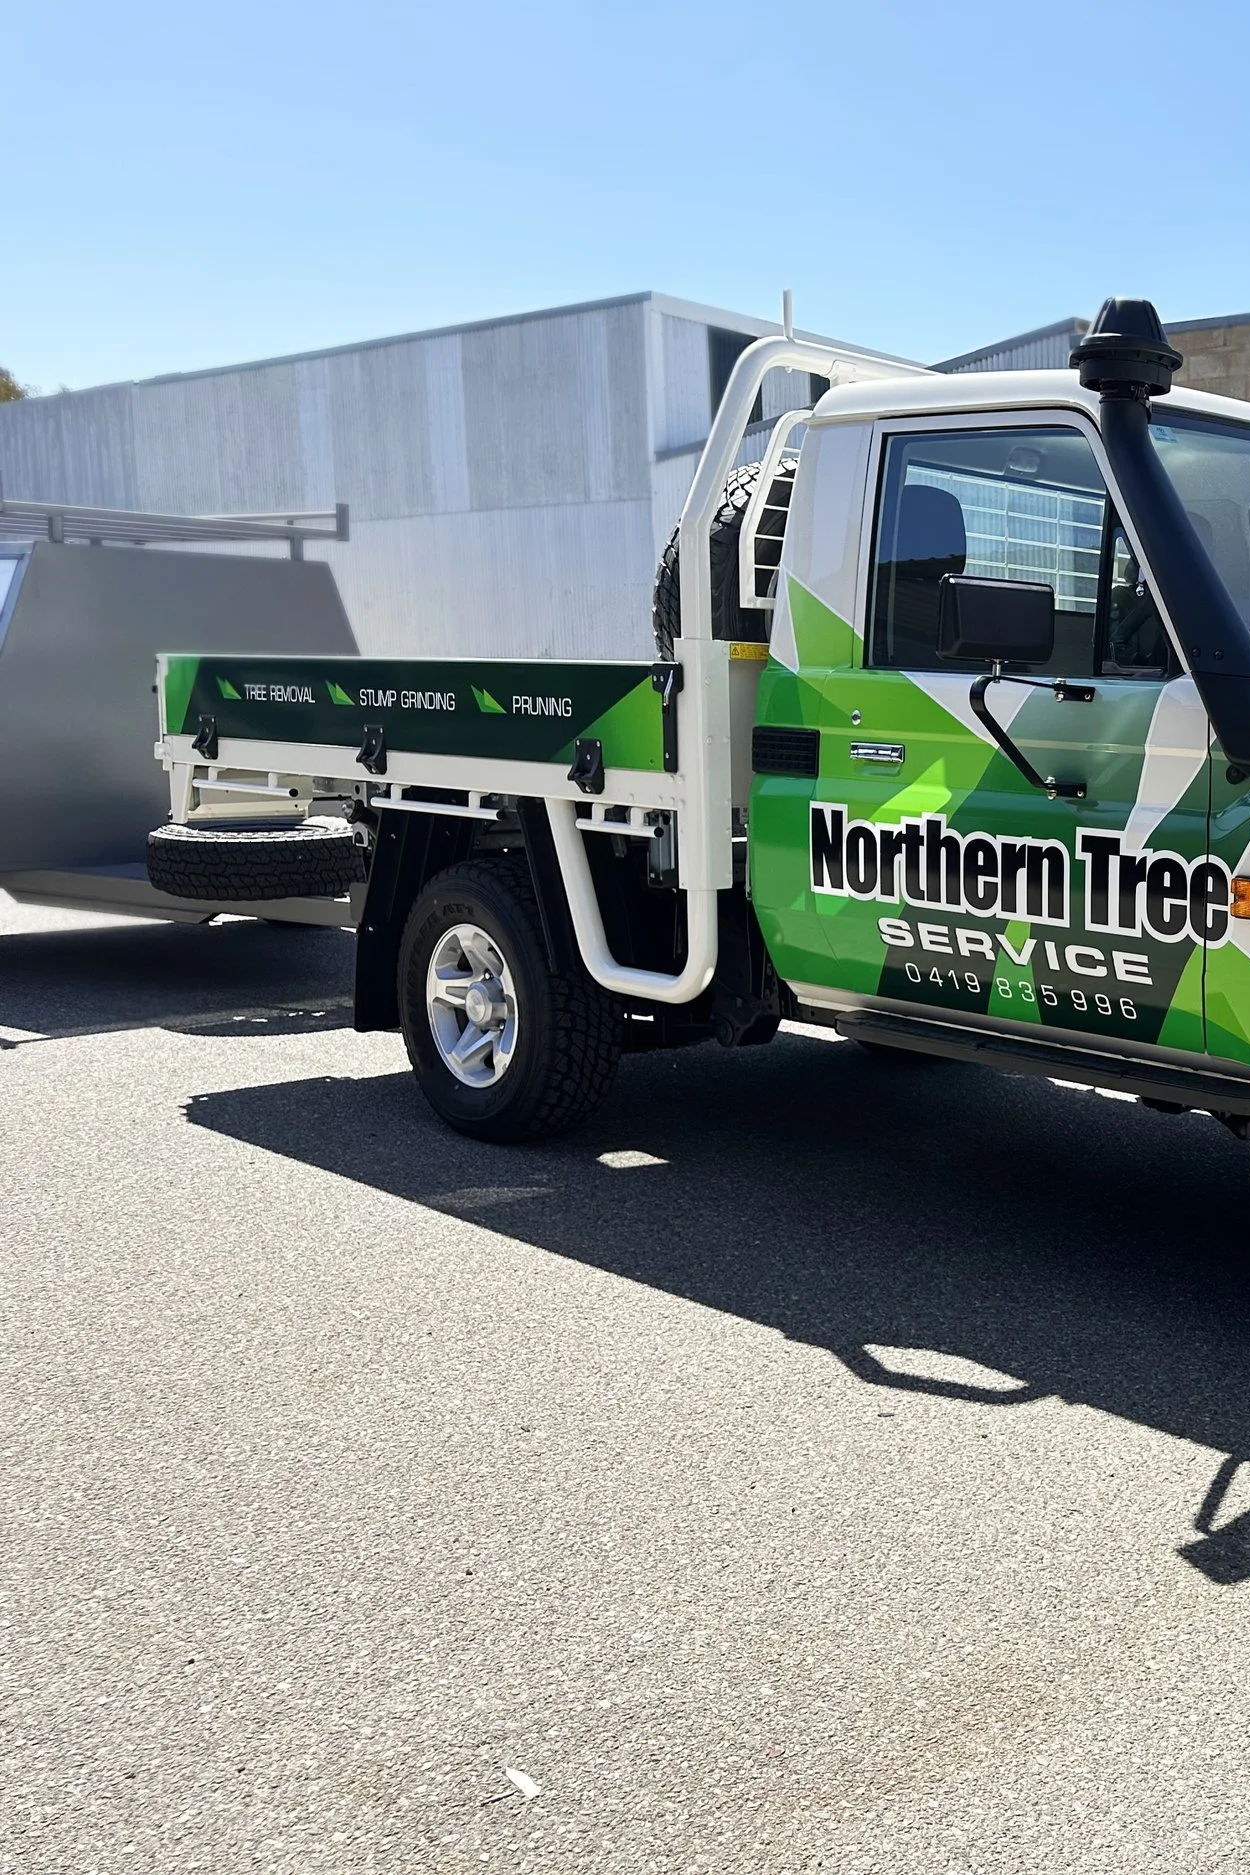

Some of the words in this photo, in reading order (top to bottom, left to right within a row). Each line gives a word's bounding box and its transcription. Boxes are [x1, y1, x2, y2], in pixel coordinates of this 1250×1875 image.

[243, 684, 267, 701] TREE
[269, 685, 316, 704] REMOVAL
[359, 688, 397, 708] STUMP
[399, 690, 456, 711] GRINDING
[512, 695, 572, 717] PRUNING
[810, 802, 1068, 925] Northern
[1077, 829, 1233, 946] Tree
[878, 917, 1153, 986] SERVICE
[904, 962, 981, 993] 0419
[996, 977, 1058, 1006] 835
[1070, 989, 1137, 1020] 996
